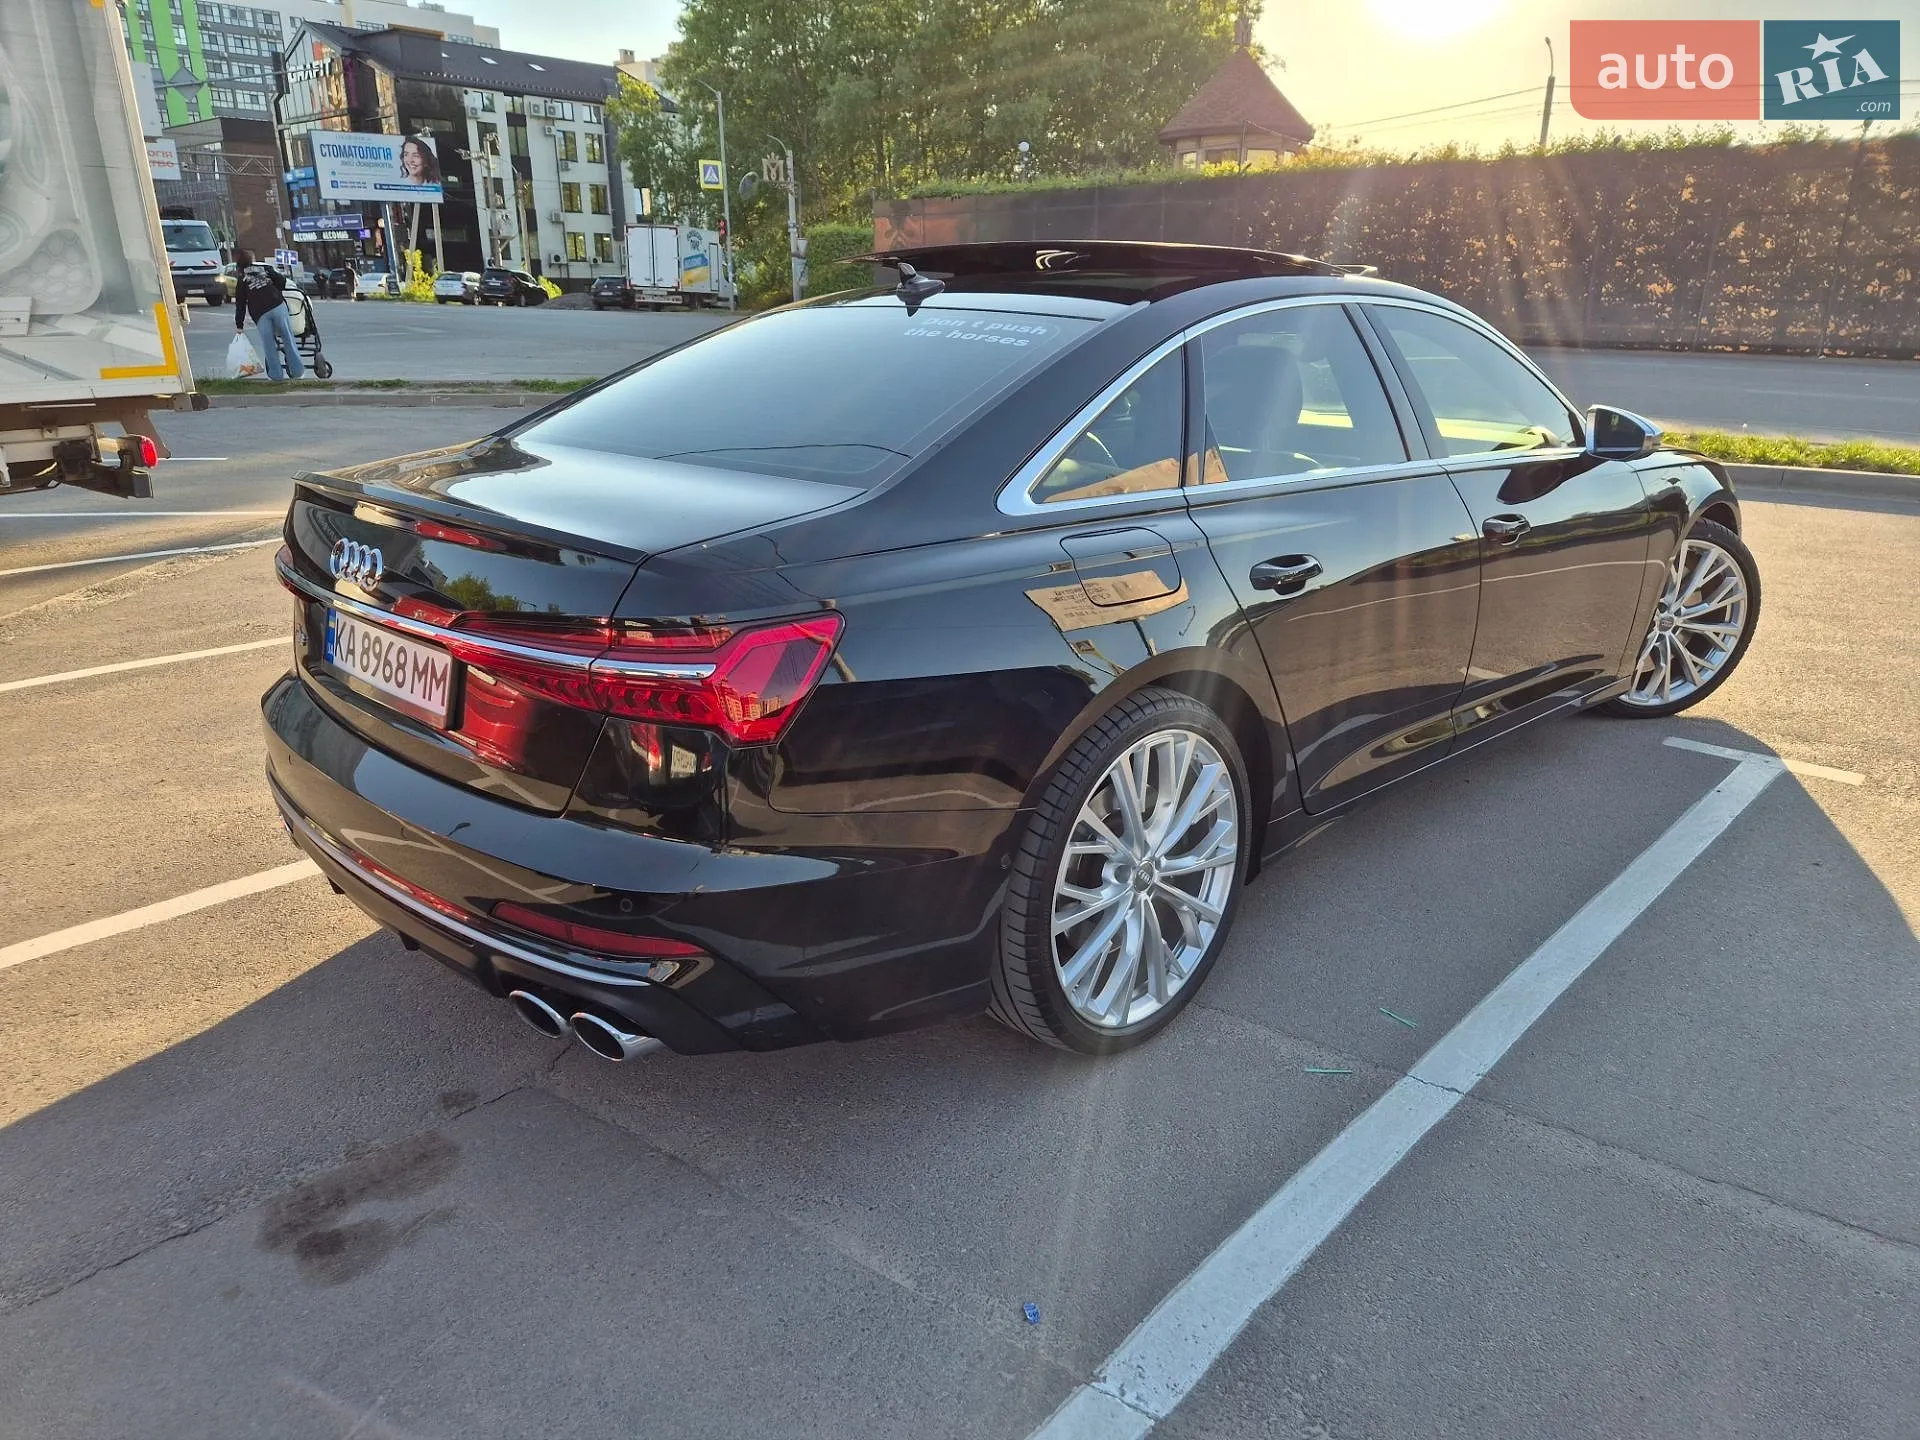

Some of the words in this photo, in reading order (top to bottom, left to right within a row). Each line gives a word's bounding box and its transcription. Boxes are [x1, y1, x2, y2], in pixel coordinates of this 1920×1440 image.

[319, 143, 393, 161] СТОМАТОЛОГІЯ
[921, 317, 985, 328] Dont
[984, 321, 1048, 336] push
[904, 327, 943, 338] the
[945, 329, 1031, 347] horses
[334, 618, 356, 669] KA
[359, 631, 408, 689] 8968
[410, 650, 449, 707] MM
